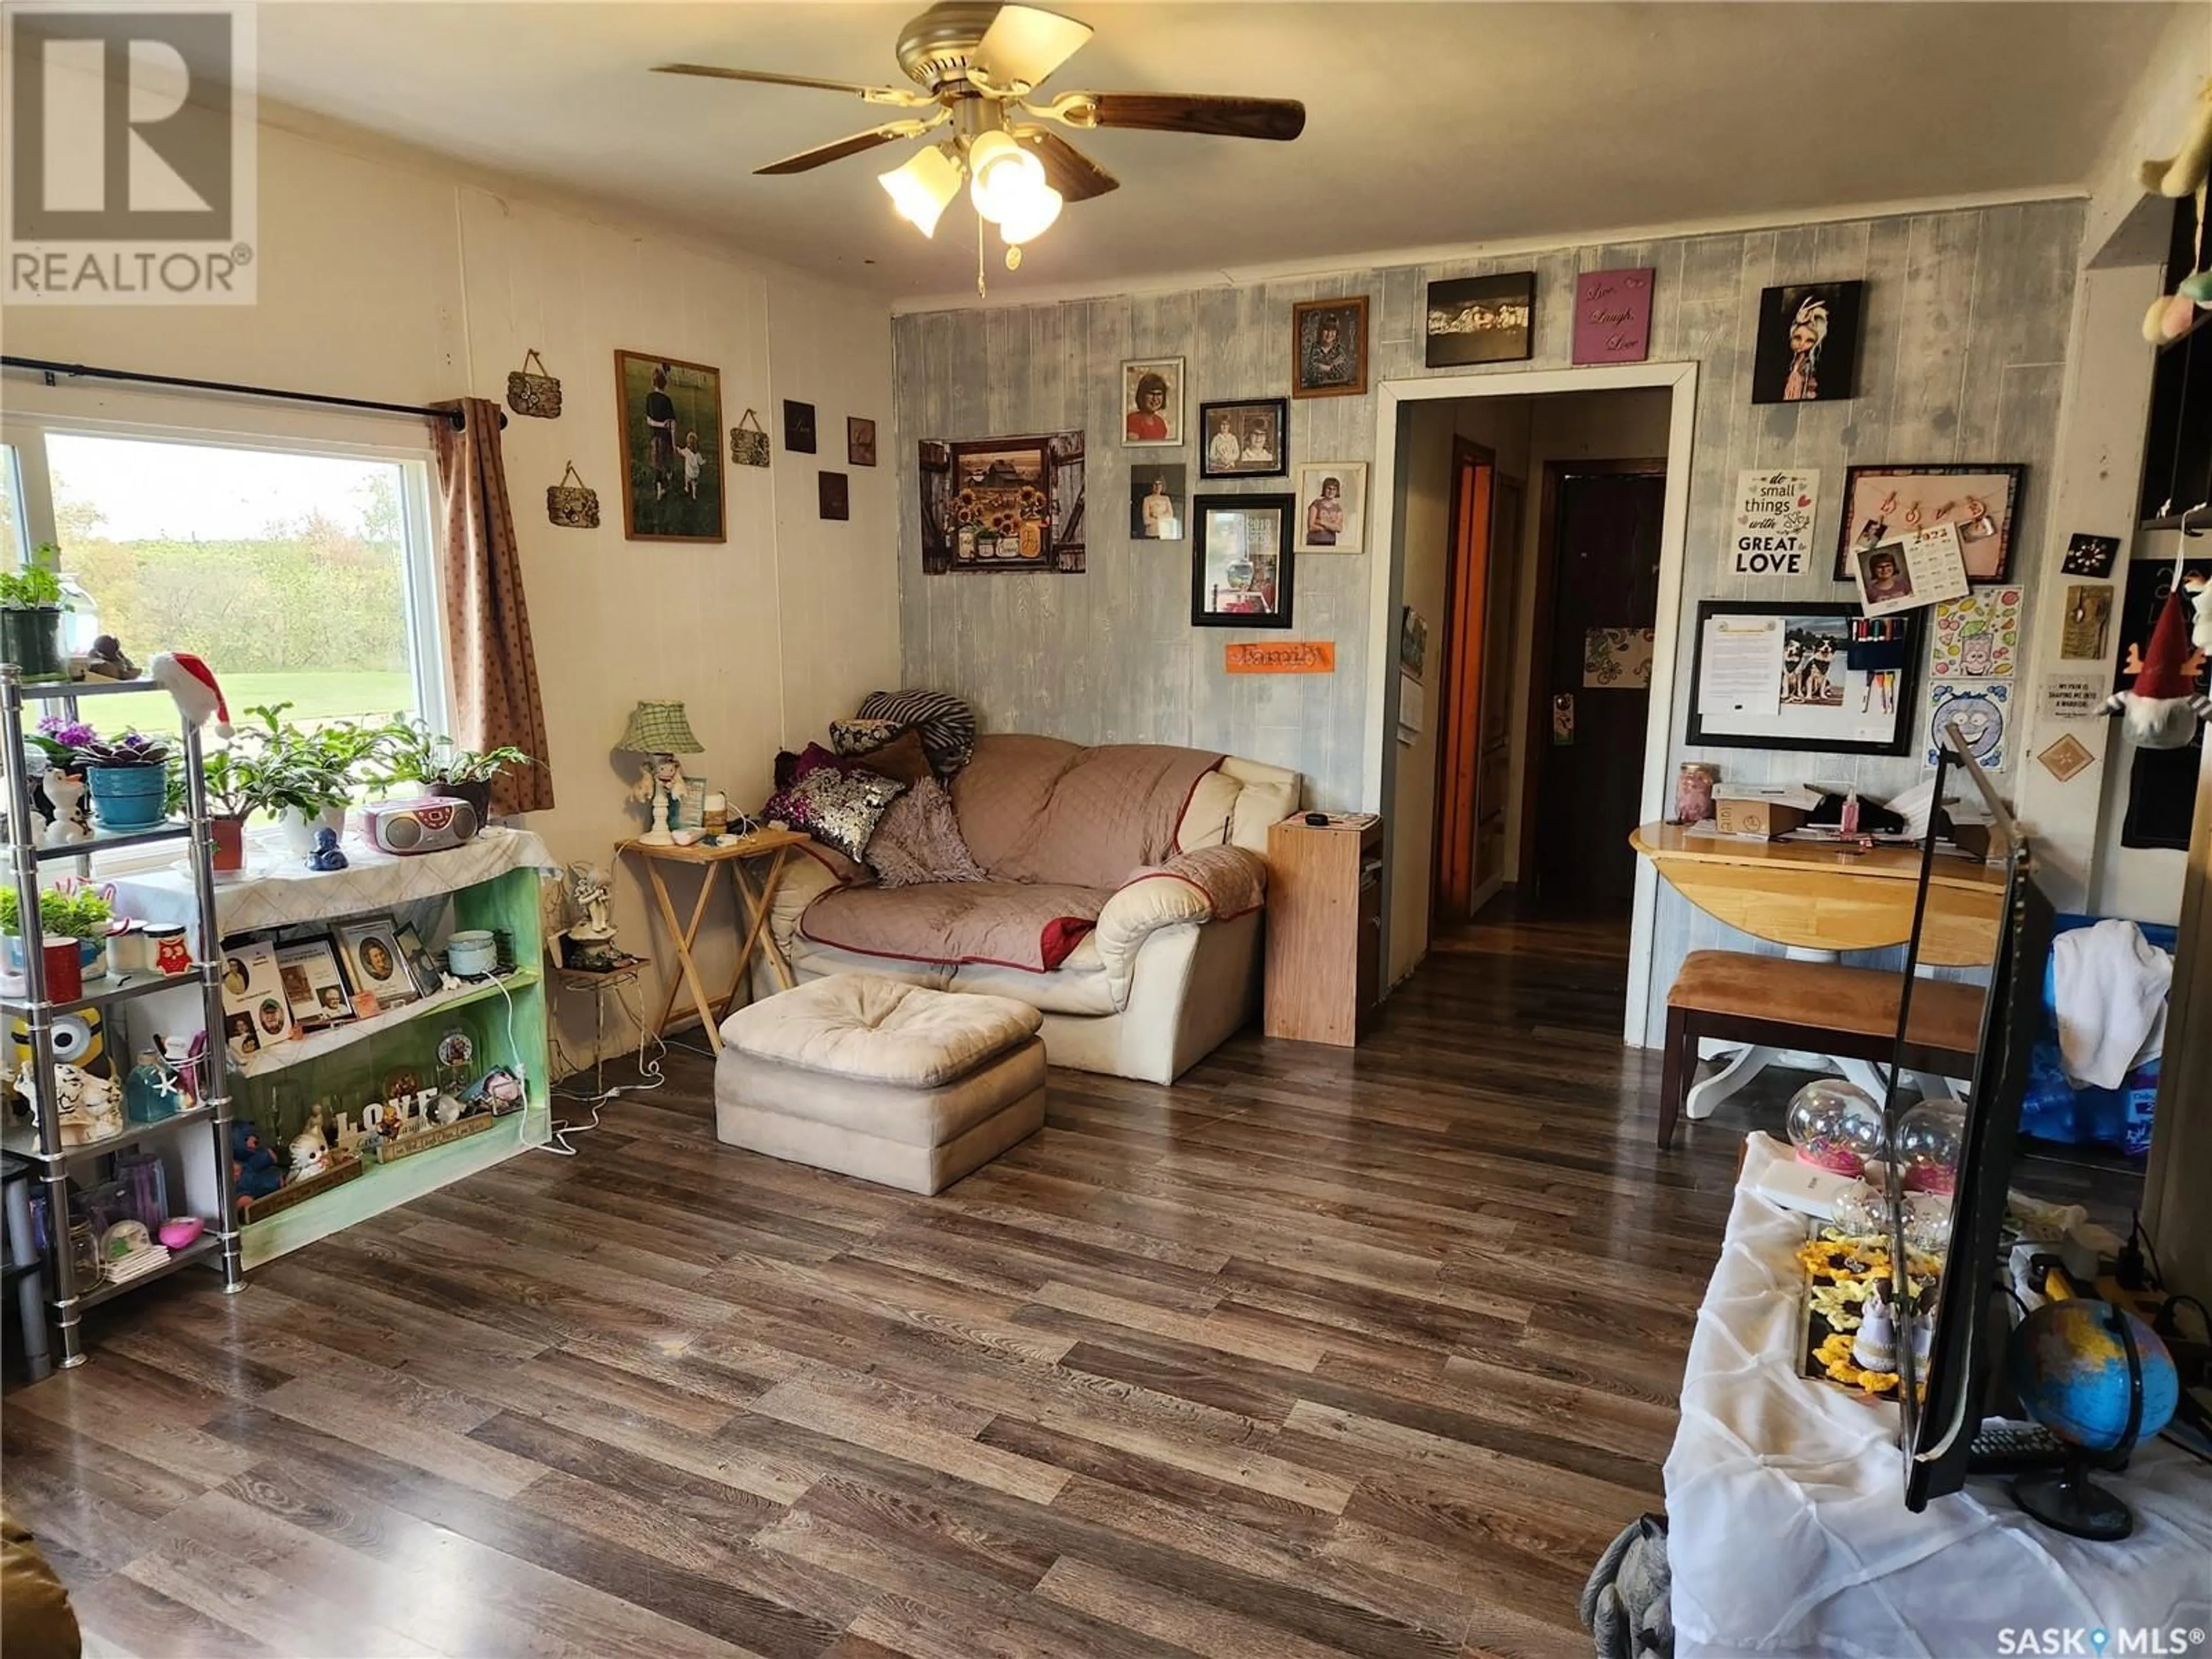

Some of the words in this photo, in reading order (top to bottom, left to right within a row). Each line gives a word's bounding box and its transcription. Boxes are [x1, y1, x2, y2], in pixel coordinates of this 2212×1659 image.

[1770, 472, 1786, 484] do
[1760, 484, 1794, 497] small
[1745, 498, 1790, 516] things
[1749, 518, 1776, 529] with
[1738, 536, 1798, 551] GREAT
[1736, 553, 1801, 574] LOVE
